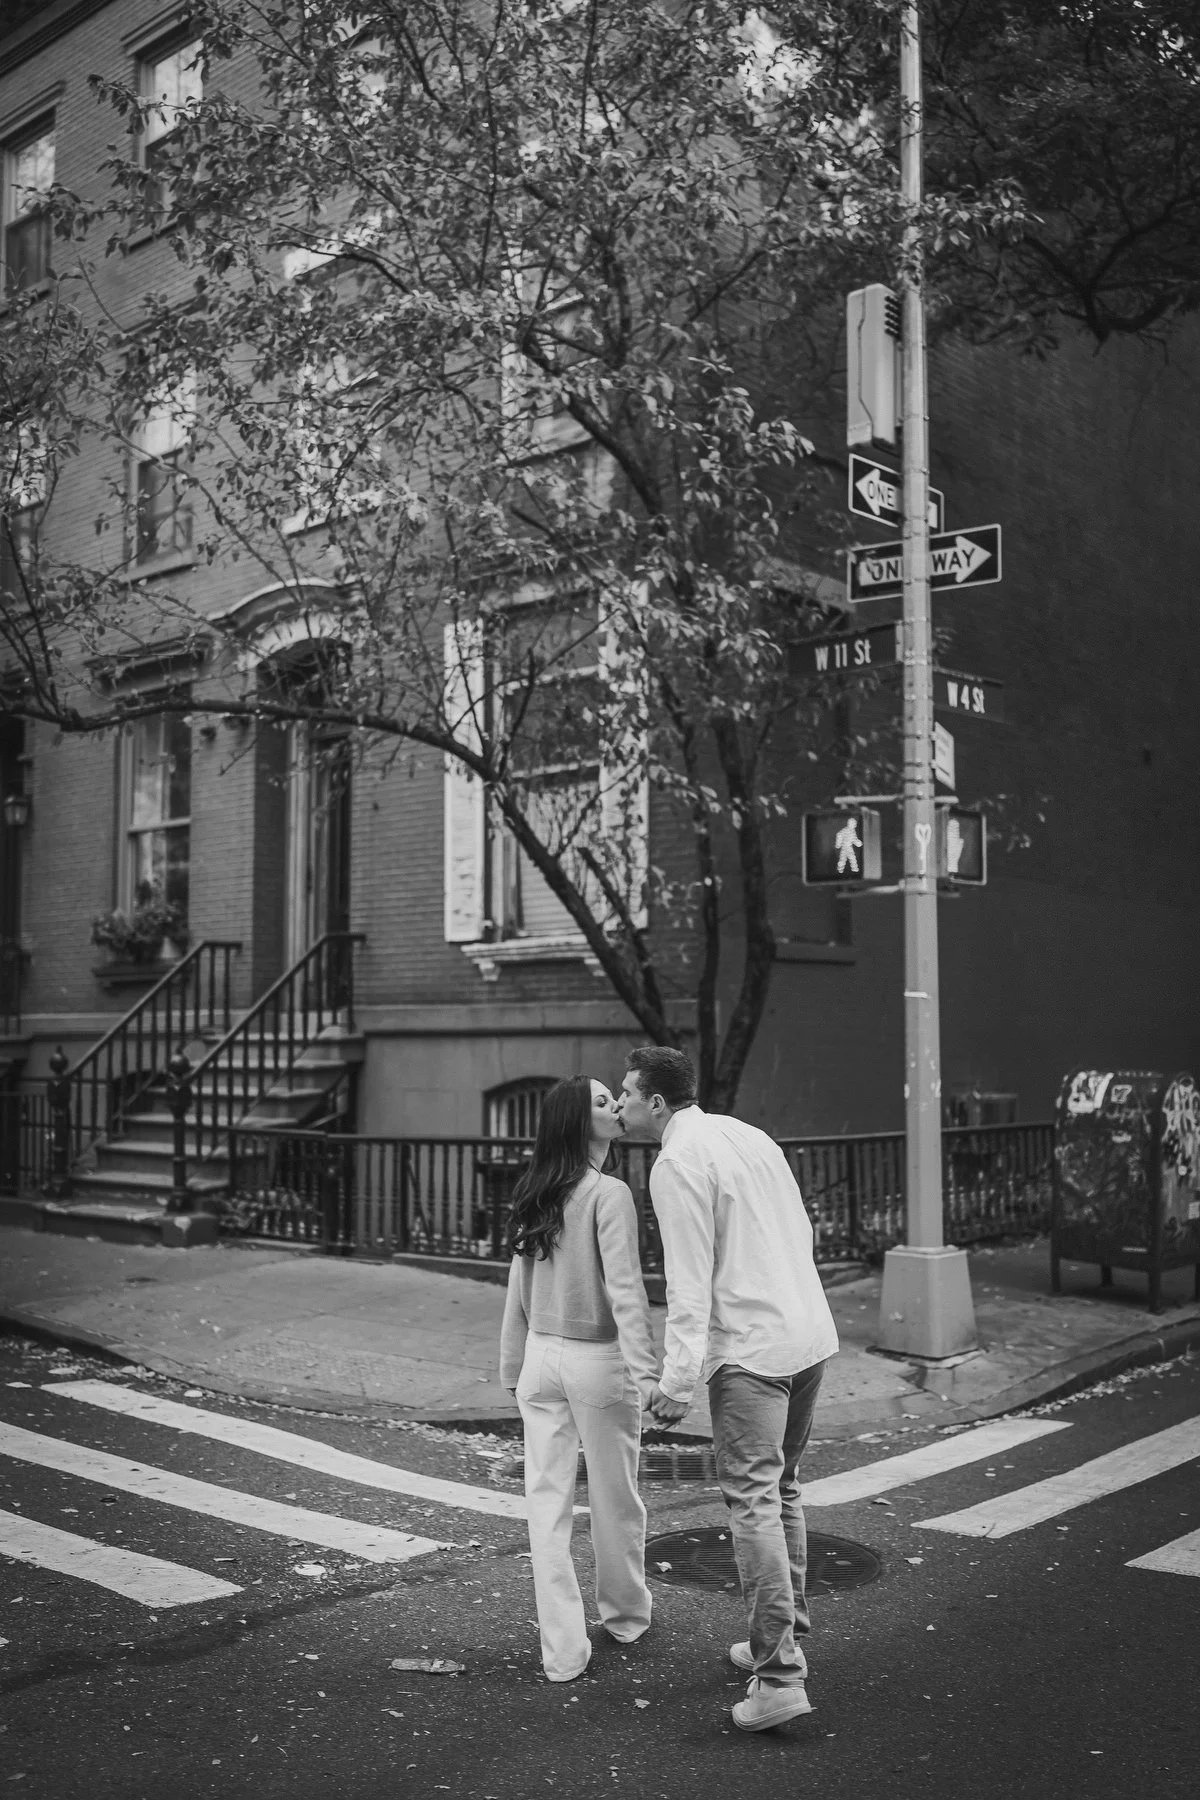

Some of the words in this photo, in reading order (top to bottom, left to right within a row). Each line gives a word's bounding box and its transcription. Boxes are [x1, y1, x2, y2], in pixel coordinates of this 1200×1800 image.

[867, 480, 896, 508] ONE
[866, 558, 904, 582] ON
[932, 548, 975, 572] WAY
[814, 645, 829, 672] W
[834, 643, 848, 668] 11
[854, 638, 872, 665] St
[946, 680, 959, 708] W
[960, 684, 970, 711] 4
[972, 686, 986, 714] St
